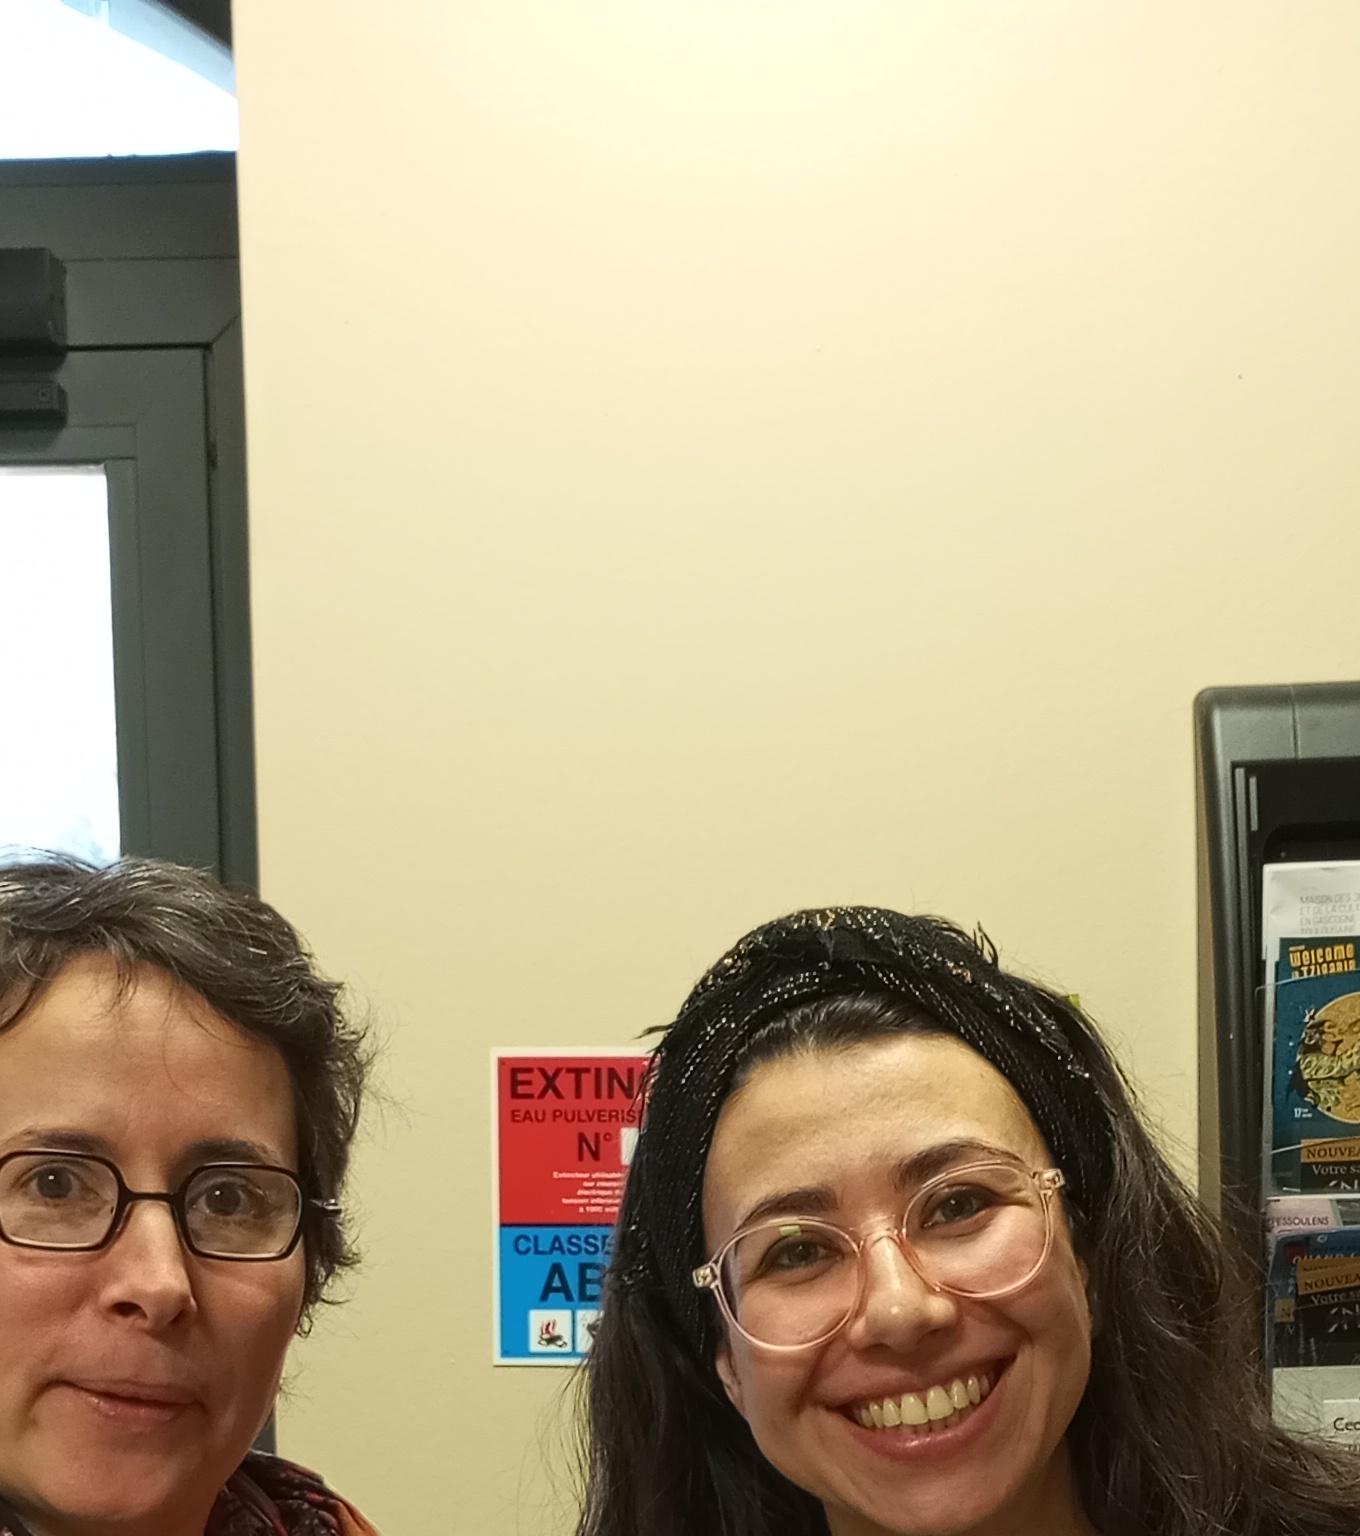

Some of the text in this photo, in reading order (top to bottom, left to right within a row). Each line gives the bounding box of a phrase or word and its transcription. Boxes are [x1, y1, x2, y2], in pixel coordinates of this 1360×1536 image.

[509, 1066, 639, 1101] EXTIN
[510, 1107, 638, 1124] EAU PULVERIS
[576, 1131, 613, 1162] N°
[1311, 1161, 1348, 1176] Votre
[1310, 1289, 1348, 1306] Votre
